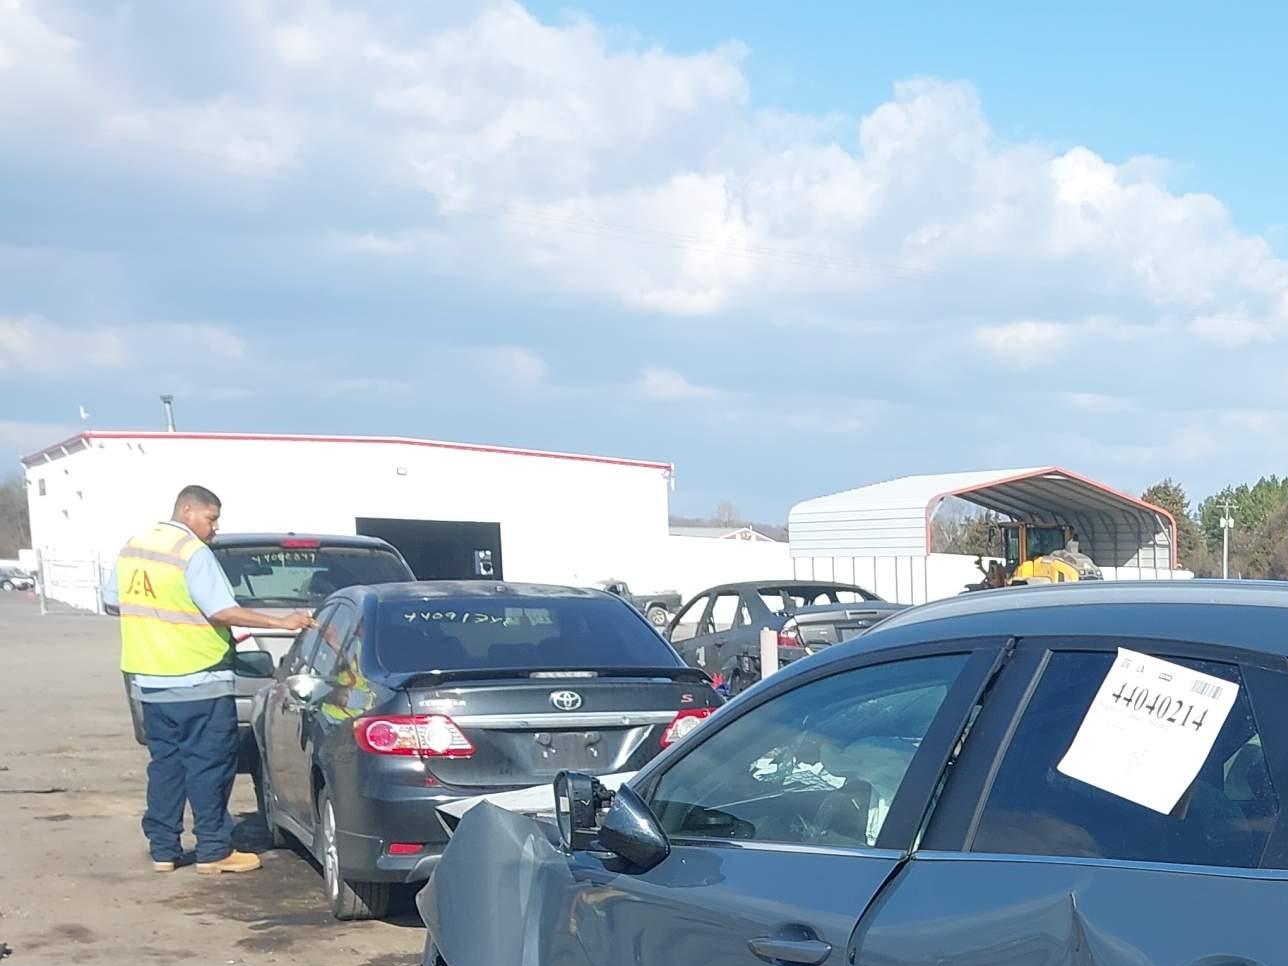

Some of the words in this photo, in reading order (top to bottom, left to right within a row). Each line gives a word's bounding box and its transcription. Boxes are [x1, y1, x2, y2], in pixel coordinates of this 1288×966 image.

[126, 568, 157, 599] IA
[680, 693, 694, 703] S
[1112, 682, 1208, 731] 44040214
